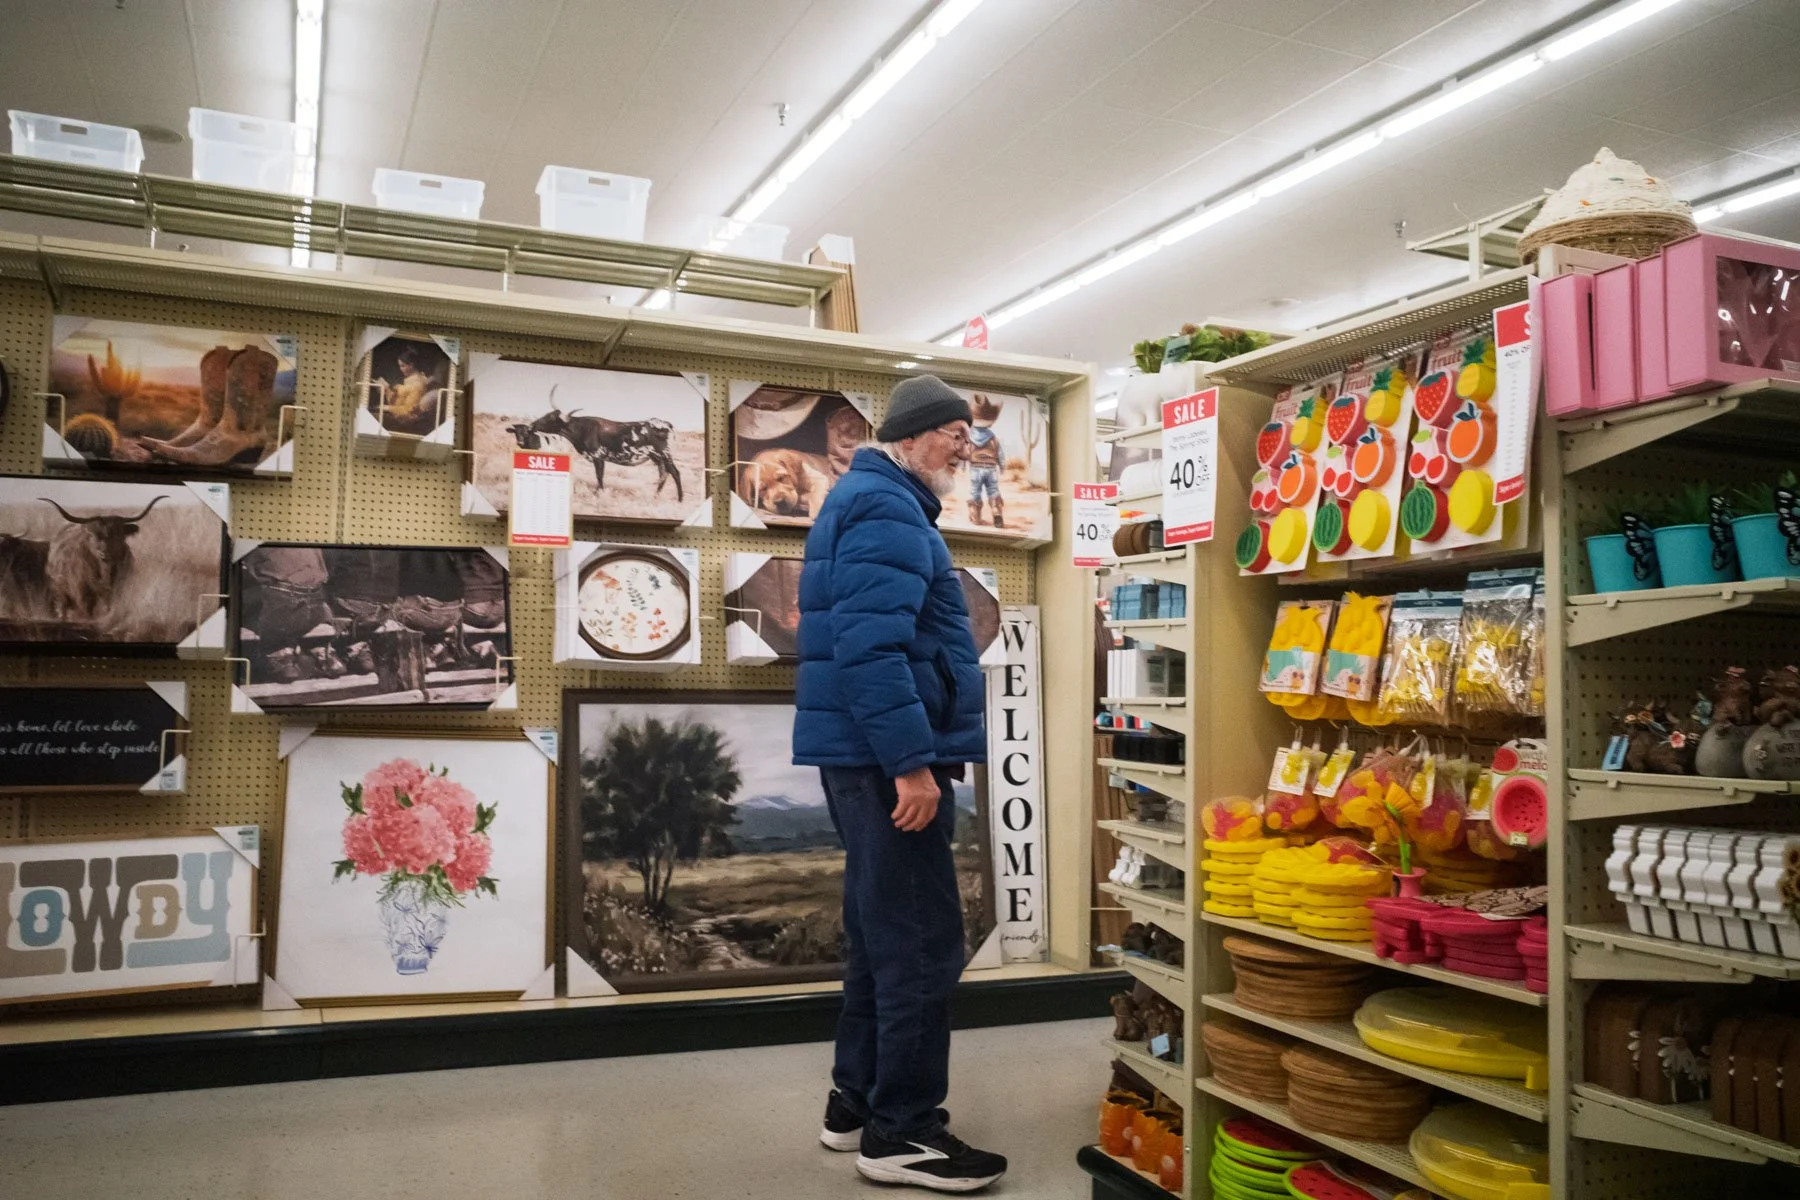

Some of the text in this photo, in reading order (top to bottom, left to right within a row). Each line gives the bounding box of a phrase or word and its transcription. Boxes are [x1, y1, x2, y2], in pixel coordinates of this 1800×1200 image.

[1174, 398, 1205, 425] SALE
[528, 455, 556, 469] SALE
[1170, 459, 1195, 490] 40
[1080, 487, 1106, 500] SALE
[1076, 523, 1098, 540] 40
[1000, 620, 1034, 923] WELCOME
[1520, 761, 1547, 770] melo
